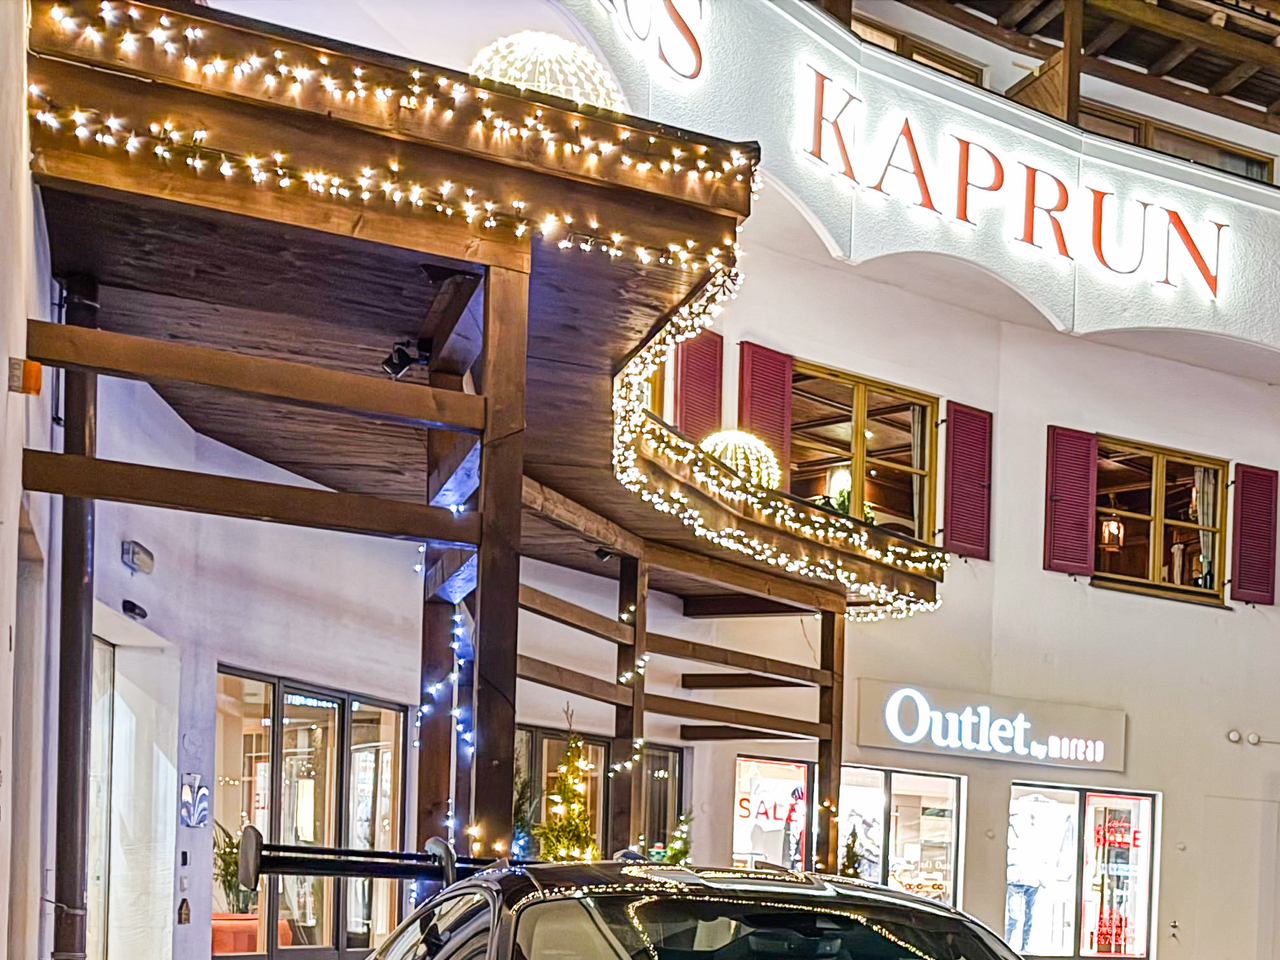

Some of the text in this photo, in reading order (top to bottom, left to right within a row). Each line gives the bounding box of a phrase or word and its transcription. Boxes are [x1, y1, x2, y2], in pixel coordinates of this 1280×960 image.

[802, 63, 1231, 298] KAPRUN
[885, 687, 1032, 756] Outlet
[738, 797, 798, 823] SALE
